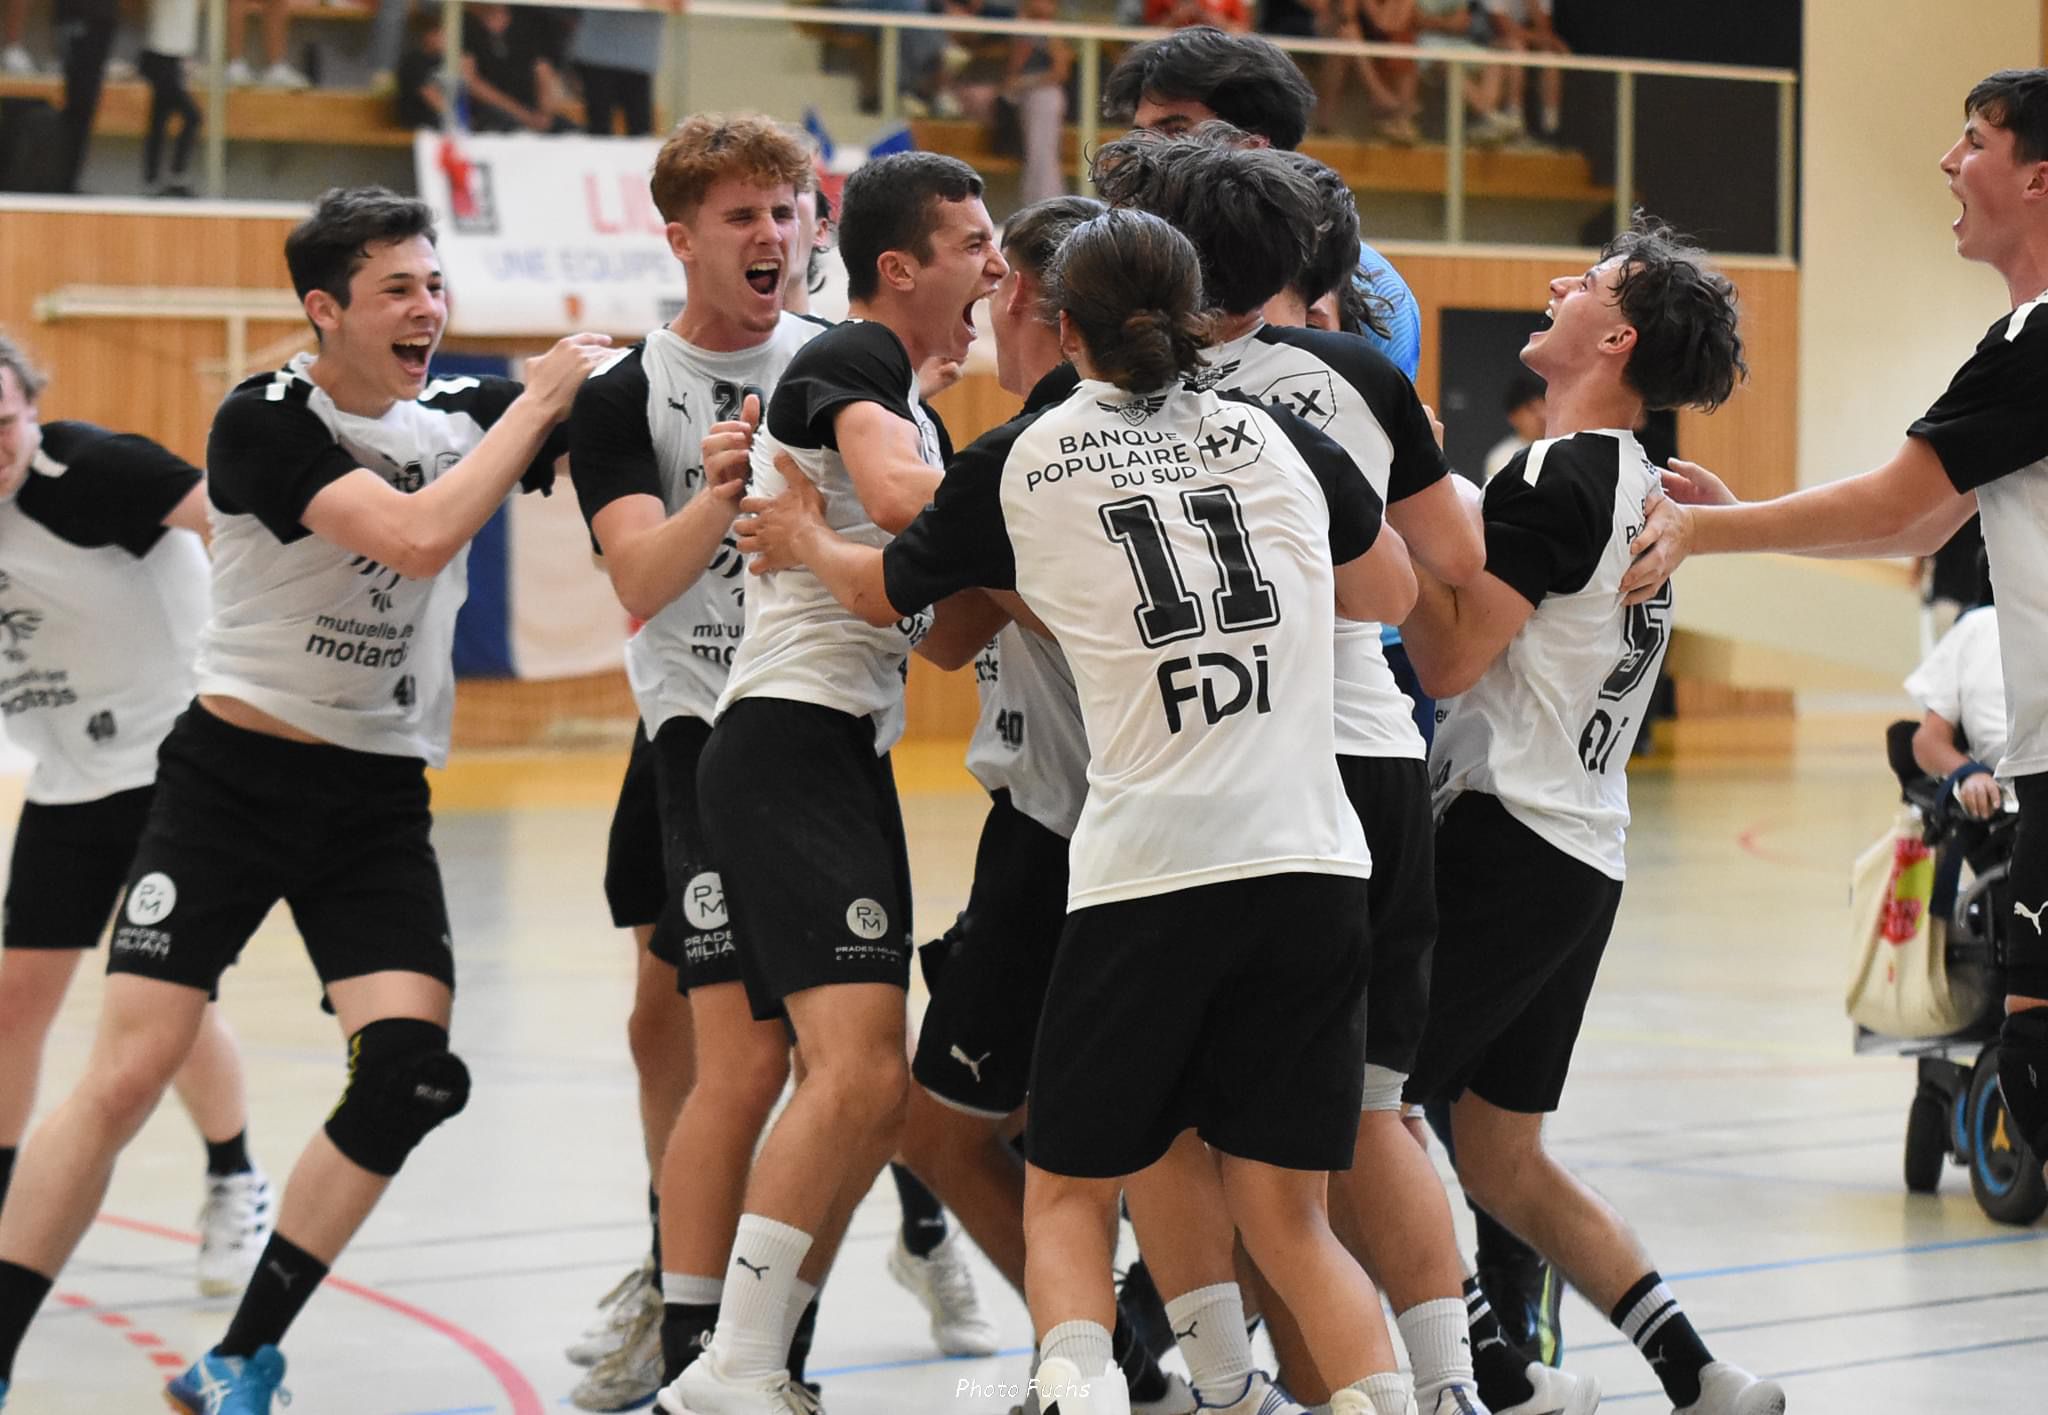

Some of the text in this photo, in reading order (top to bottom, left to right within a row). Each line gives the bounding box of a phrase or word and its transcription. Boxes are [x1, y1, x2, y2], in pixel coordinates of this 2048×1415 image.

[1059, 428, 1179, 455] BANQUE
[1026, 443, 1192, 492] POPULAIRE
[1110, 464, 1198, 489] DU SUD
[1098, 483, 1281, 650] 11
[316, 614, 398, 640] mutuelle
[305, 633, 409, 668] motard
[1157, 645, 1272, 735] FDi
